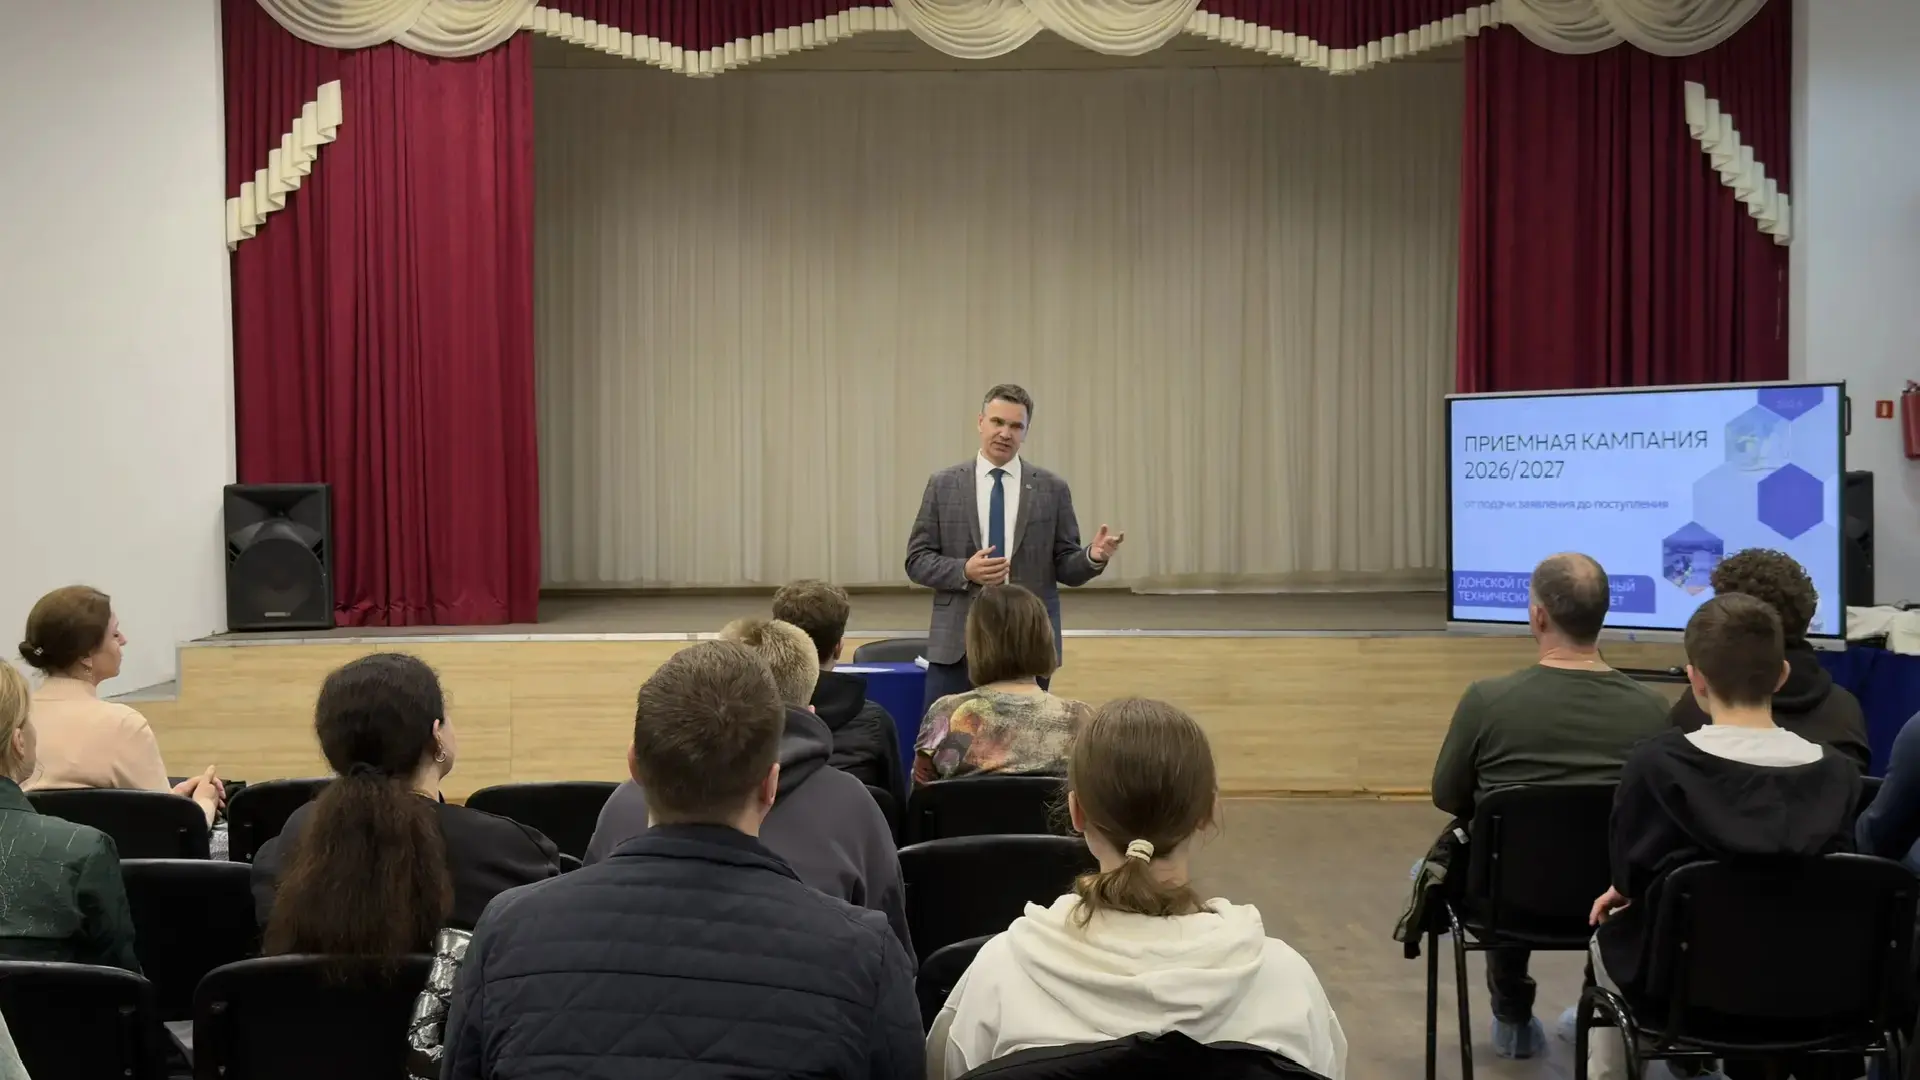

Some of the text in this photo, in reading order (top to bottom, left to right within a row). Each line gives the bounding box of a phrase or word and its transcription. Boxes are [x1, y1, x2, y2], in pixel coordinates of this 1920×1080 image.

[1465, 430, 1708, 452] ПРИЕМНАЯ КАМПАНИЯ
[1465, 460, 1565, 481] 2026/2027
[1519, 500, 1575, 510] заявления
[1577, 500, 1592, 511] до
[1594, 500, 1669, 512] поступления
[1458, 576, 1515, 589] ДОНСКОЙ
[1458, 590, 1530, 602] ТЕХНИЧЕСКИ
